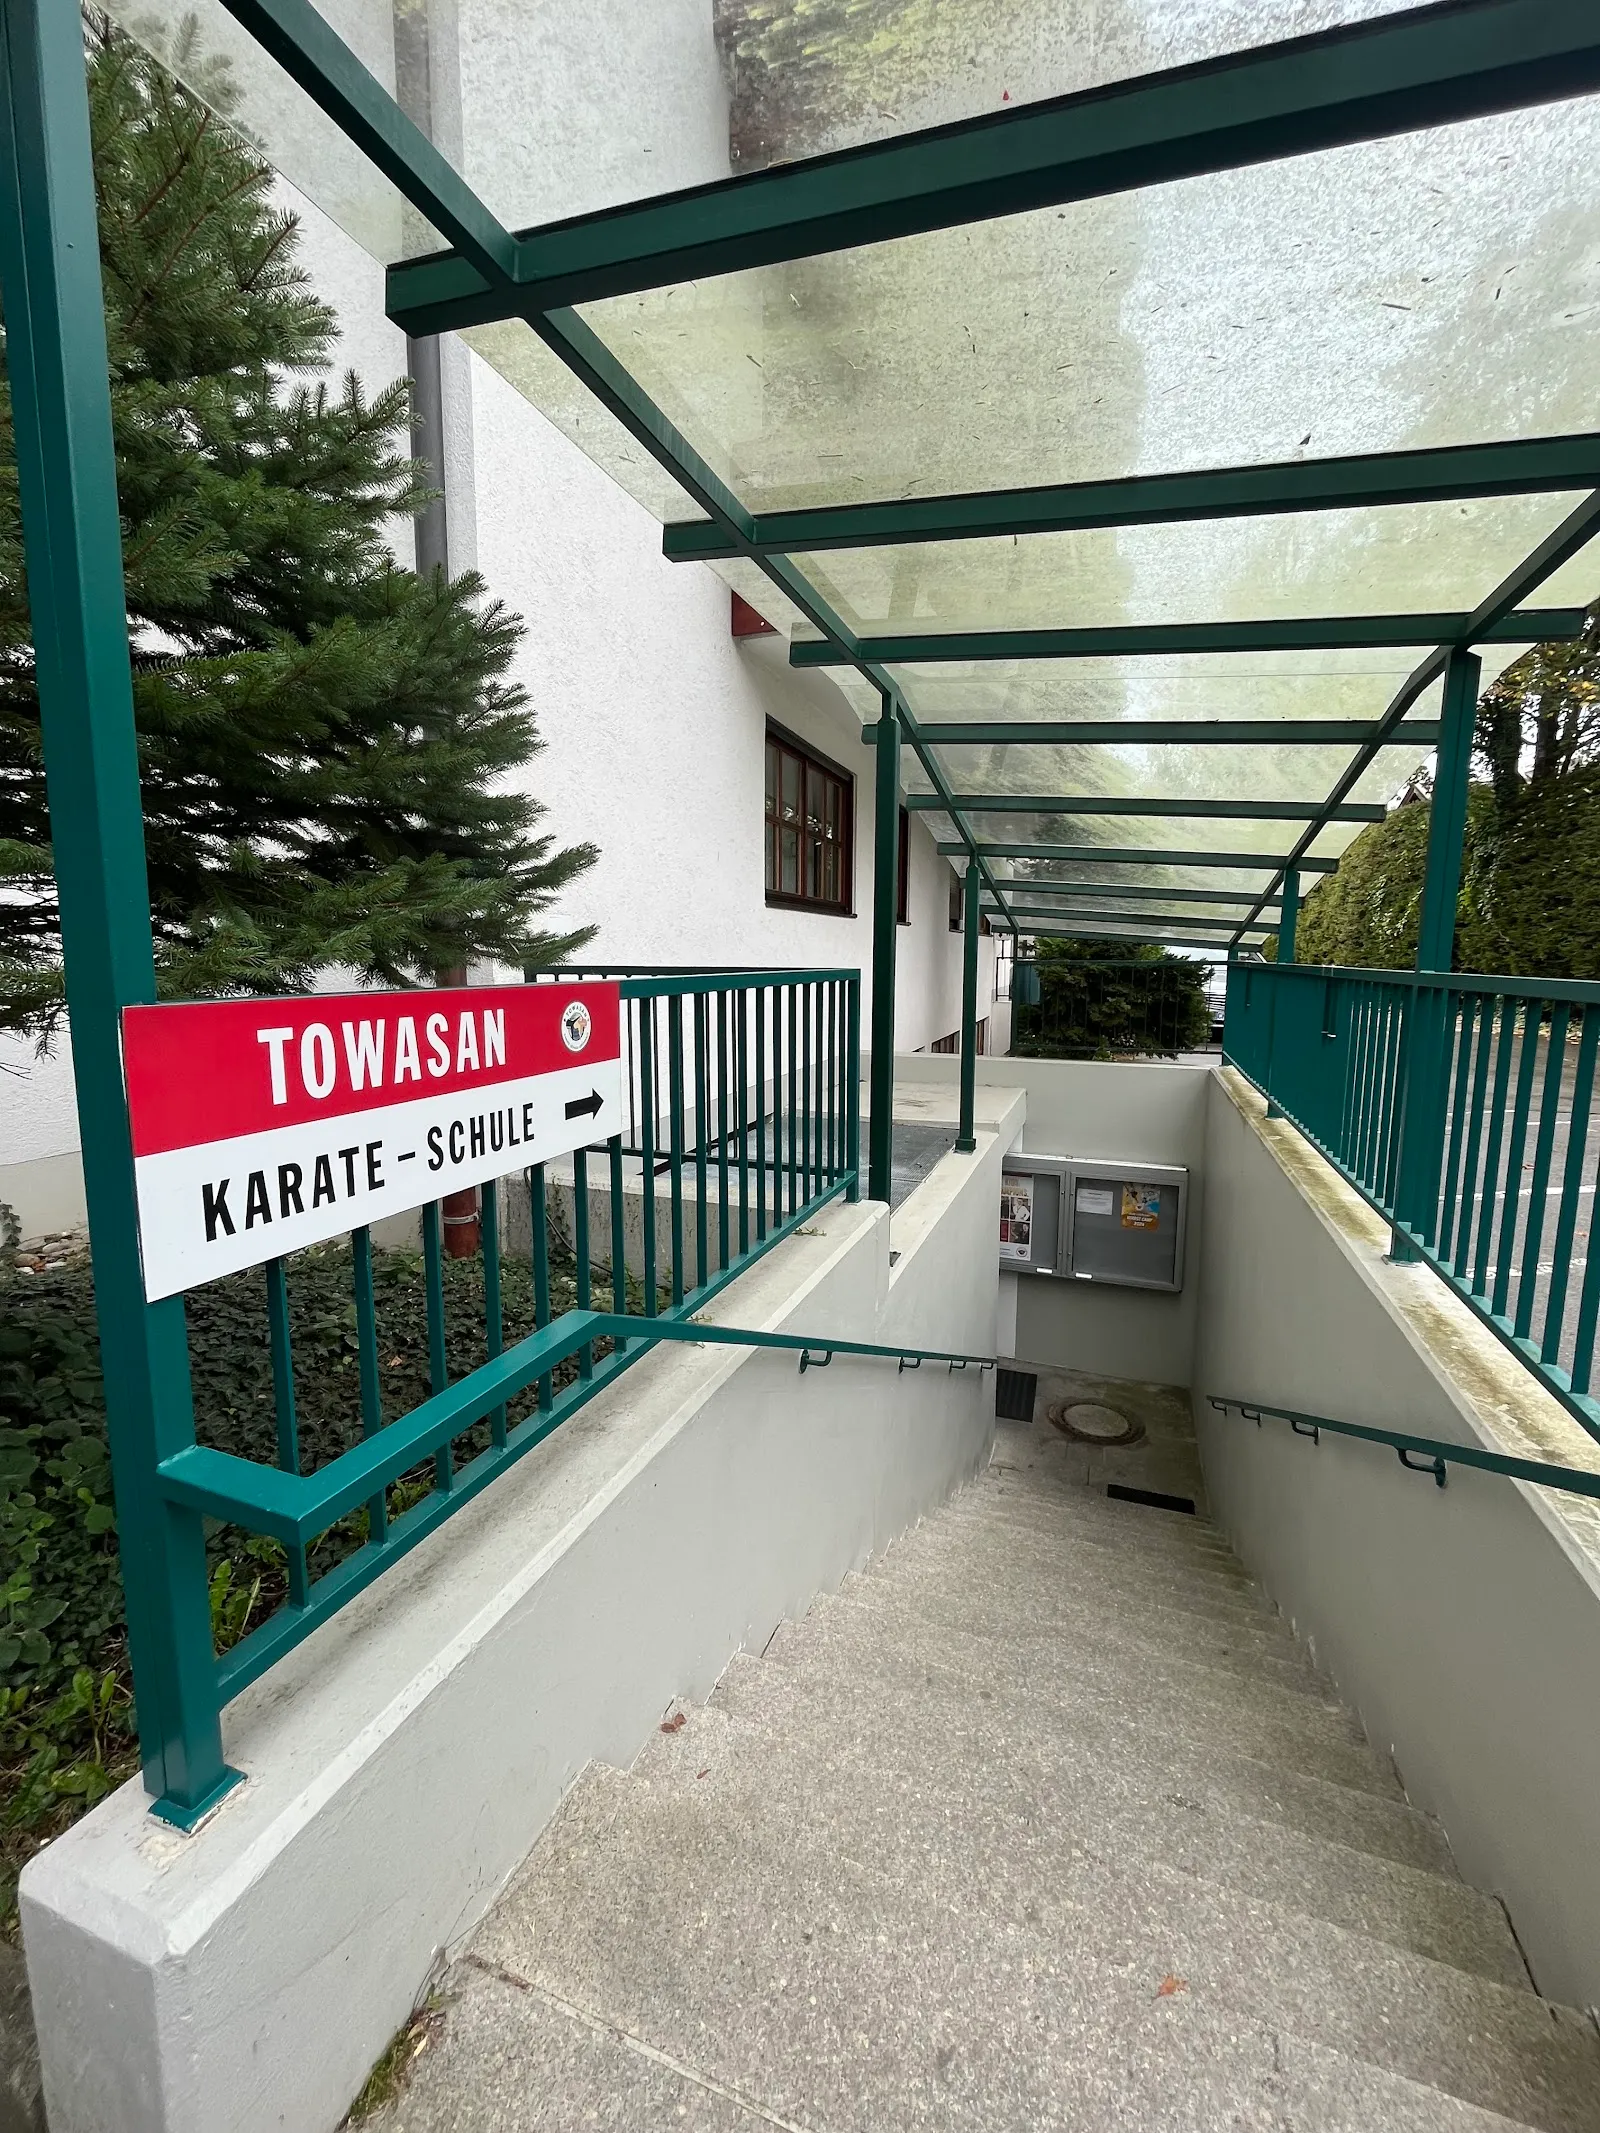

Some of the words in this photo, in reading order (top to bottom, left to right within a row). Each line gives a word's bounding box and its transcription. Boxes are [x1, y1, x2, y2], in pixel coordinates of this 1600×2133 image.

[256, 1008, 506, 1105] TOWASAN
[201, 1140, 385, 1243] KARATE
[427, 1102, 535, 1171] SCHULE
